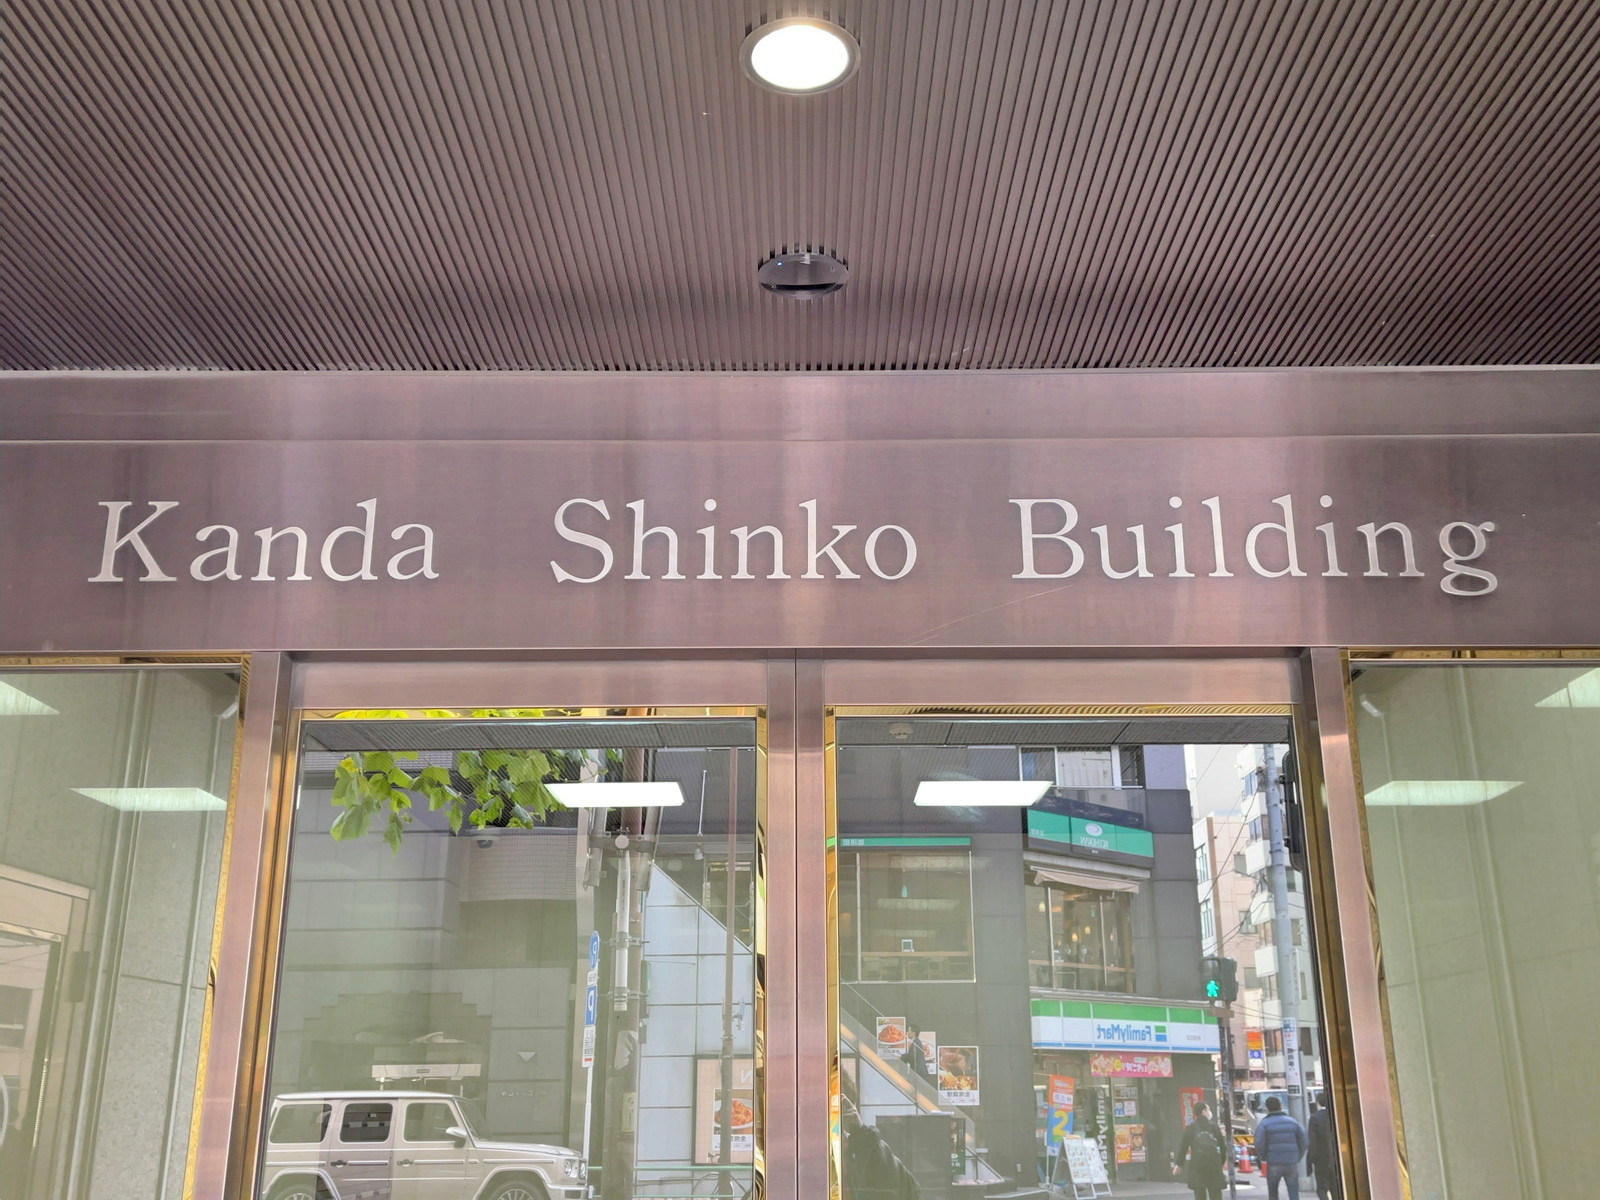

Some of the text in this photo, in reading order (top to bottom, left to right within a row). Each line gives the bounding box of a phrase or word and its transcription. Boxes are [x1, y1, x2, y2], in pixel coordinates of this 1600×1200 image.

[86, 493, 1499, 597] Kanda Shinko Building
